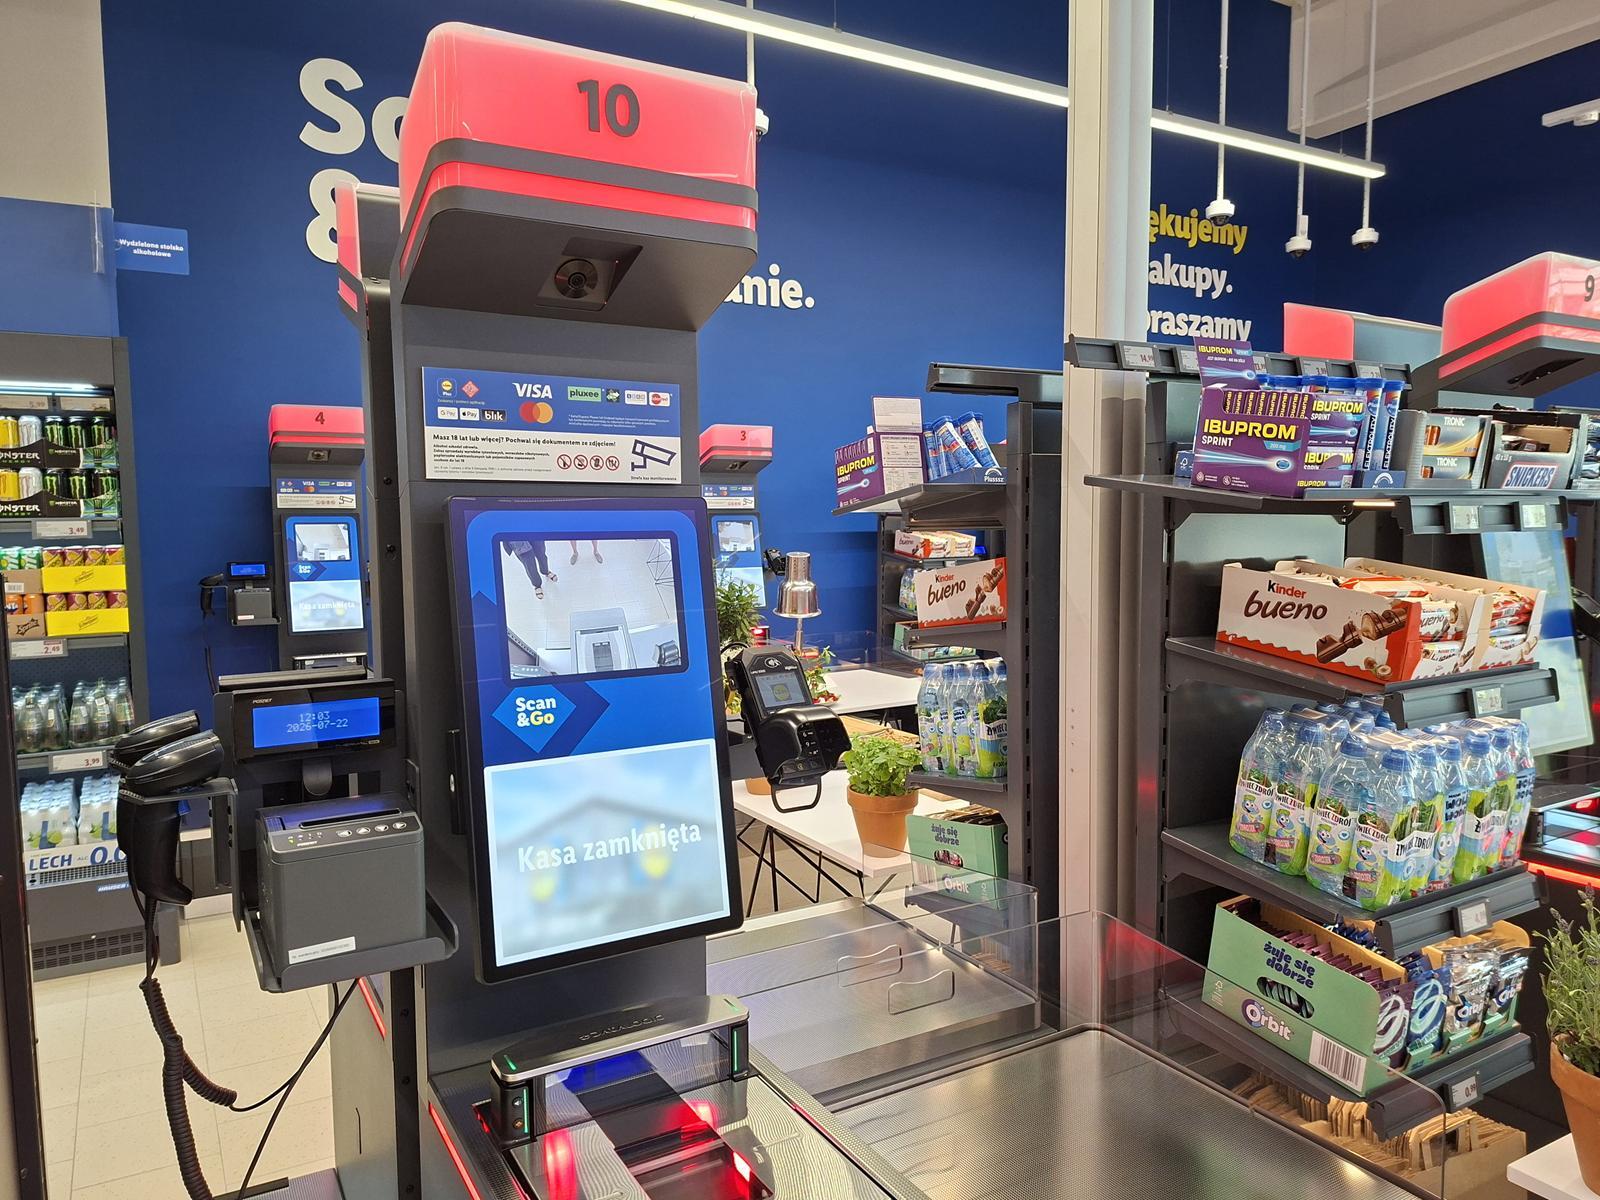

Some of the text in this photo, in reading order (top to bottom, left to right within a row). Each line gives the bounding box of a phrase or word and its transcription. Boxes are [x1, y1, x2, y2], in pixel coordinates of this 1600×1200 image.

[577, 79, 640, 137] 10
[1149, 253, 1233, 299] akupy.
[1584, 275, 1595, 302] 9
[1147, 309, 1252, 341] raszamy
[1198, 345, 1233, 355] IBUPROM
[512, 382, 552, 399] VISA
[569, 389, 599, 399] pluxee
[1313, 400, 1364, 413] IBUPROM
[315, 412, 326, 425] 4
[484, 410, 504, 421] blik
[1444, 417, 1466, 427] TRONIC
[740, 430, 747, 441] 3
[1203, 418, 1297, 440] IBUPROM
[481, 436, 504, 444] więcej?
[1201, 435, 1233, 447] SPRINT
[837, 455, 875, 477] IBUPROM
[1436, 456, 1458, 467] TRONIC
[1505, 466, 1554, 488] SNICKERS
[69, 527, 84, 535] 3.49
[935, 573, 955, 583] Kinder
[928, 579, 967, 606] bueno
[1268, 579, 1307, 600] Kinder
[1243, 589, 1328, 621] bueno
[44, 645, 60, 654] 2.49
[515, 697, 557, 713] Scan
[300, 711, 330, 723] 12:03
[516, 710, 556, 728] &Go
[286, 718, 349, 733] 2026-07-22
[931, 823, 958, 839] żuje się
[934, 832, 960, 846] dobrze
[517, 822, 702, 873] Kasa zamknięta
[29, 853, 72, 871] LECH
[944, 877, 970, 894] Orbit
[1263, 941, 1316, 977] żuje się
[1266, 957, 1314, 989] dobrze
[1245, 1002, 1292, 1041] Orbit
